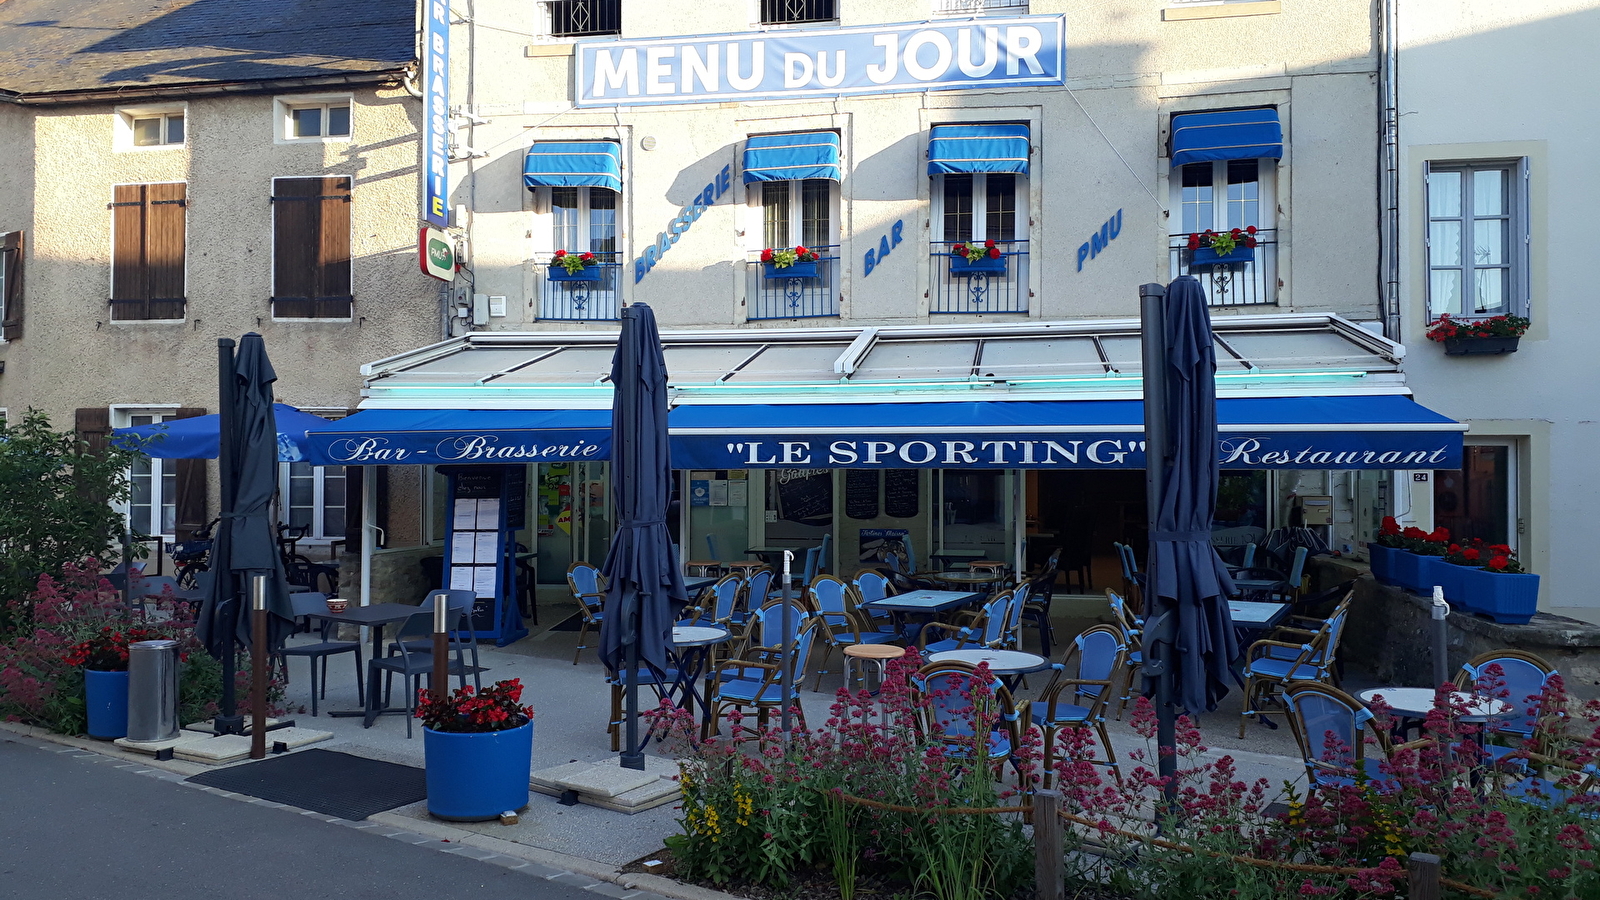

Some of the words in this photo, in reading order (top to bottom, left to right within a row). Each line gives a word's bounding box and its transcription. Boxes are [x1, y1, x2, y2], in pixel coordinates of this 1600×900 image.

[592, 40, 765, 97] MENU
[784, 49, 846, 88] DU
[866, 26, 1044, 84] JOUR
[431, 31, 445, 217] BRASSERIE
[431, 247, 444, 260] PMU
[634, 164, 730, 285] BRASSERIE
[864, 219, 903, 277] BAR
[1077, 208, 1122, 273] PMU
[328, 437, 411, 461] Bar
[436, 434, 602, 461] Brasserie
[726, 441, 812, 464] "LE
[829, 440, 1146, 464] SPORTING"
[1218, 436, 1448, 465] Restaurant
